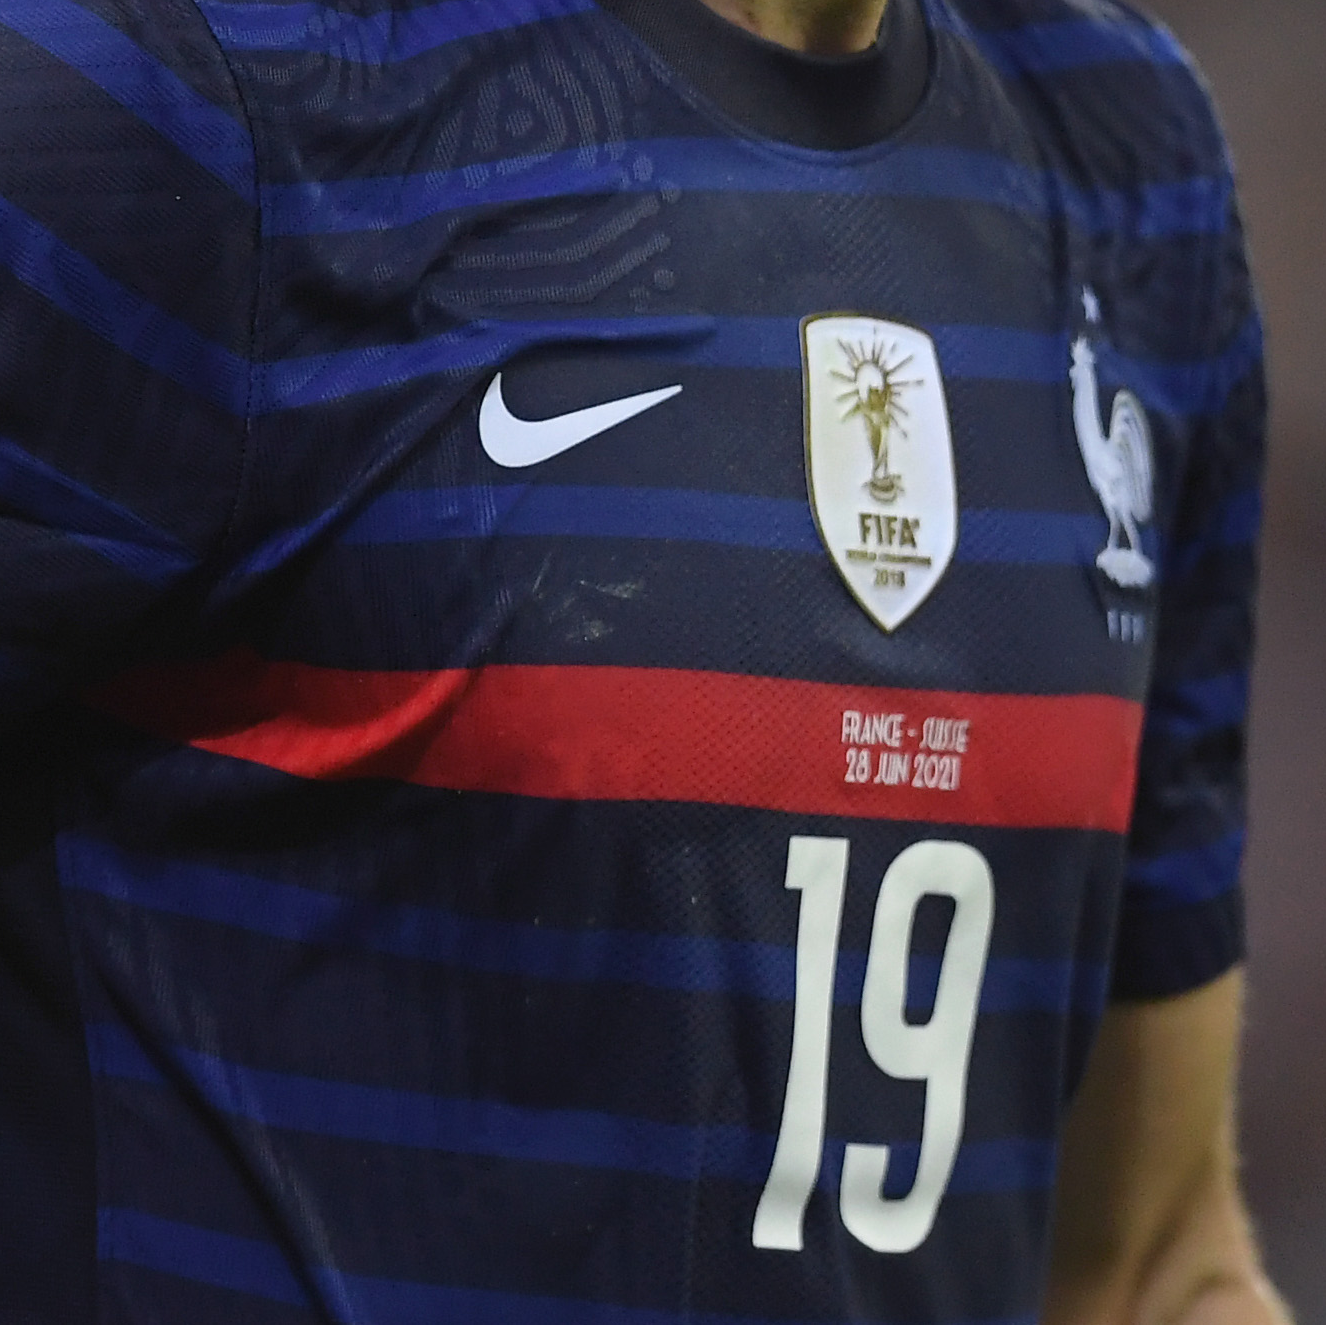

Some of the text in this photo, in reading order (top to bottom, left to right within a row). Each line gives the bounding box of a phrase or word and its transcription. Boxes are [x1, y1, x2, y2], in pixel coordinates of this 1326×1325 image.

[858, 512, 918, 548] FIFA
[841, 710, 905, 748] FRANCE
[844, 747, 871, 783] 28
[911, 753, 962, 791] 2021
[752, 835, 996, 1254] 19
